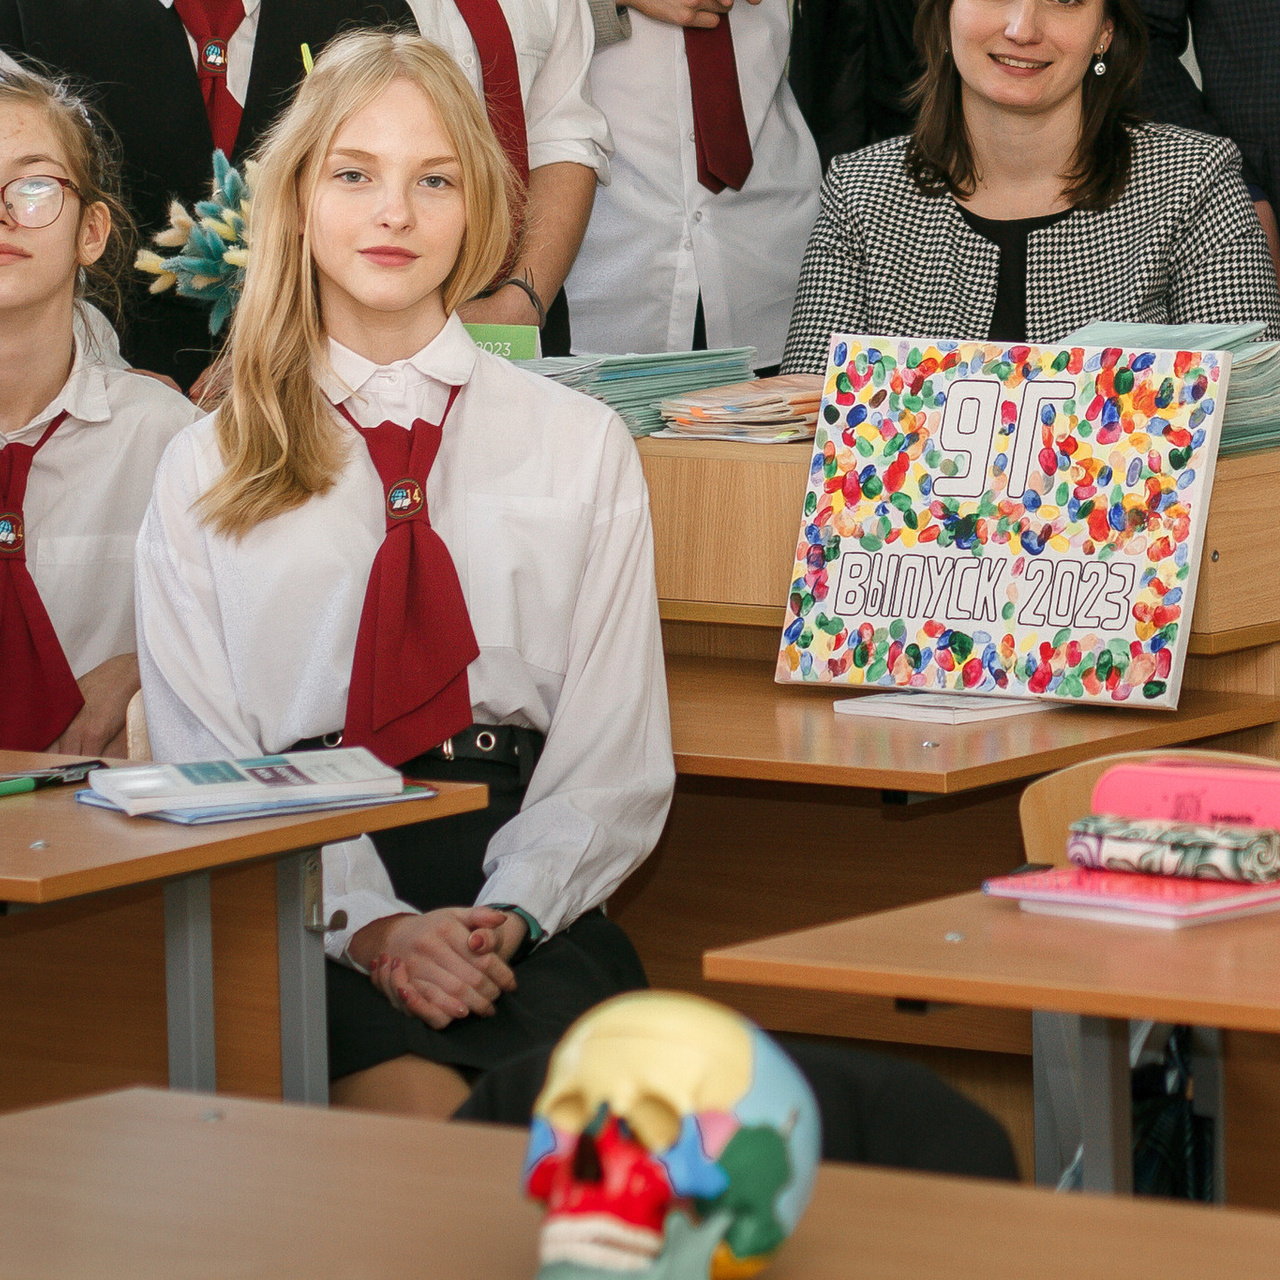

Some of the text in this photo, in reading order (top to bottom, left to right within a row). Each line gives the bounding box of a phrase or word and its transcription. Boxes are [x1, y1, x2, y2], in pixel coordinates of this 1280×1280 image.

[932, 379, 1077, 498] 9Г
[407, 486, 421, 504] 14
[834, 551, 1137, 631] ВЫПУСК 2023
